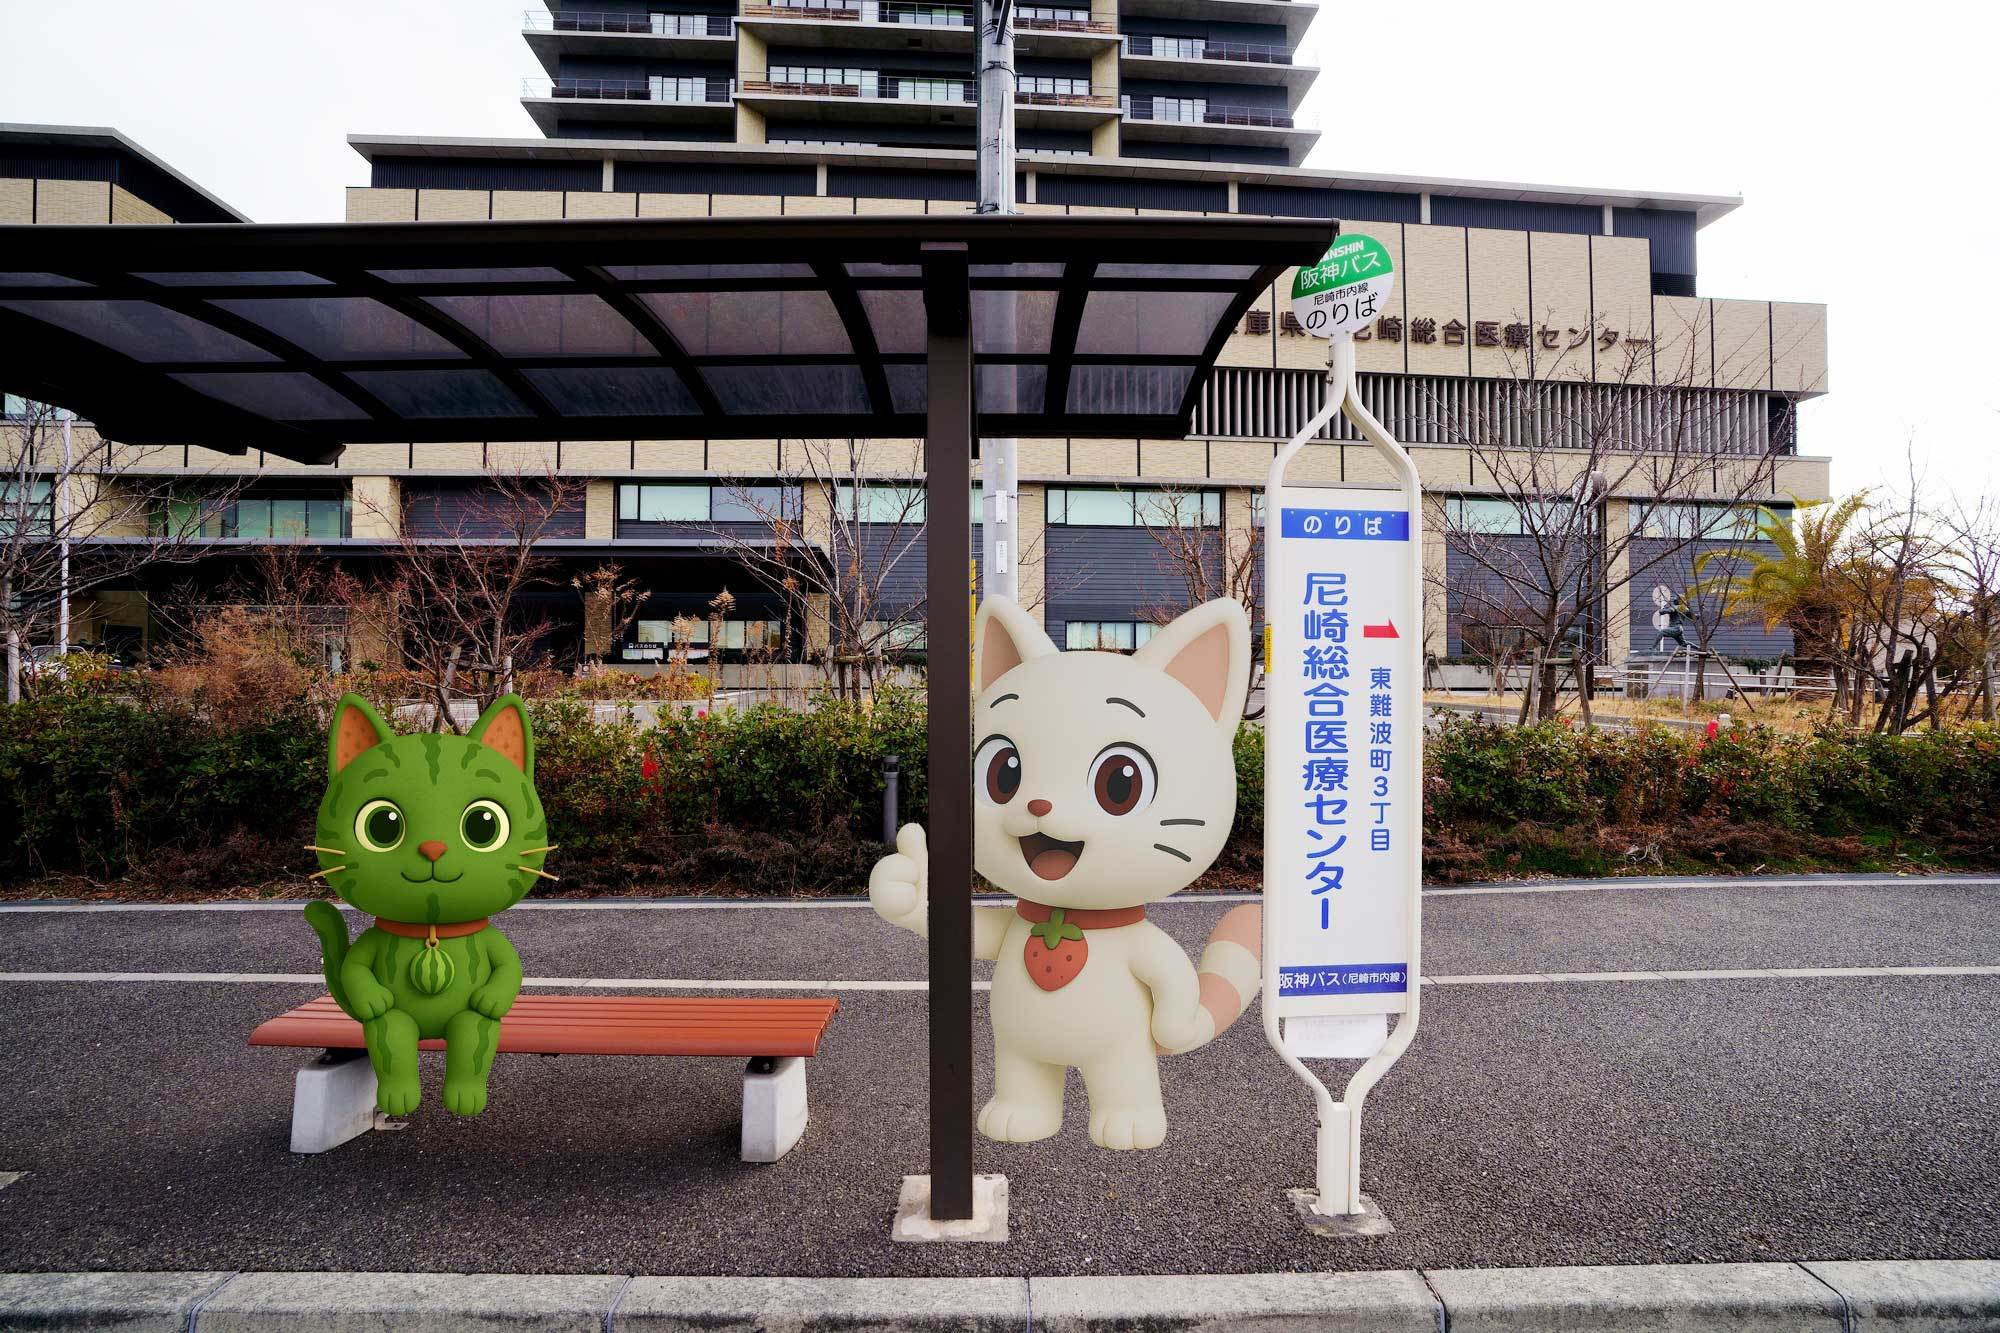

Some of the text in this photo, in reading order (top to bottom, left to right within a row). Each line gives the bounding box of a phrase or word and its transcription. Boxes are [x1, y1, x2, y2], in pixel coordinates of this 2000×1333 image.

[1320, 240, 1364, 262] ANSHIN
[1300, 252, 1381, 290] 阪神バス
[1306, 292, 1378, 329] のりば
[1314, 282, 1368, 306] 尼崎市内線
[1303, 516, 1382, 535] のりば
[1303, 572, 1349, 929] 尼崎総合医療センター
[1370, 667, 1392, 851] 東難波町3丁目
